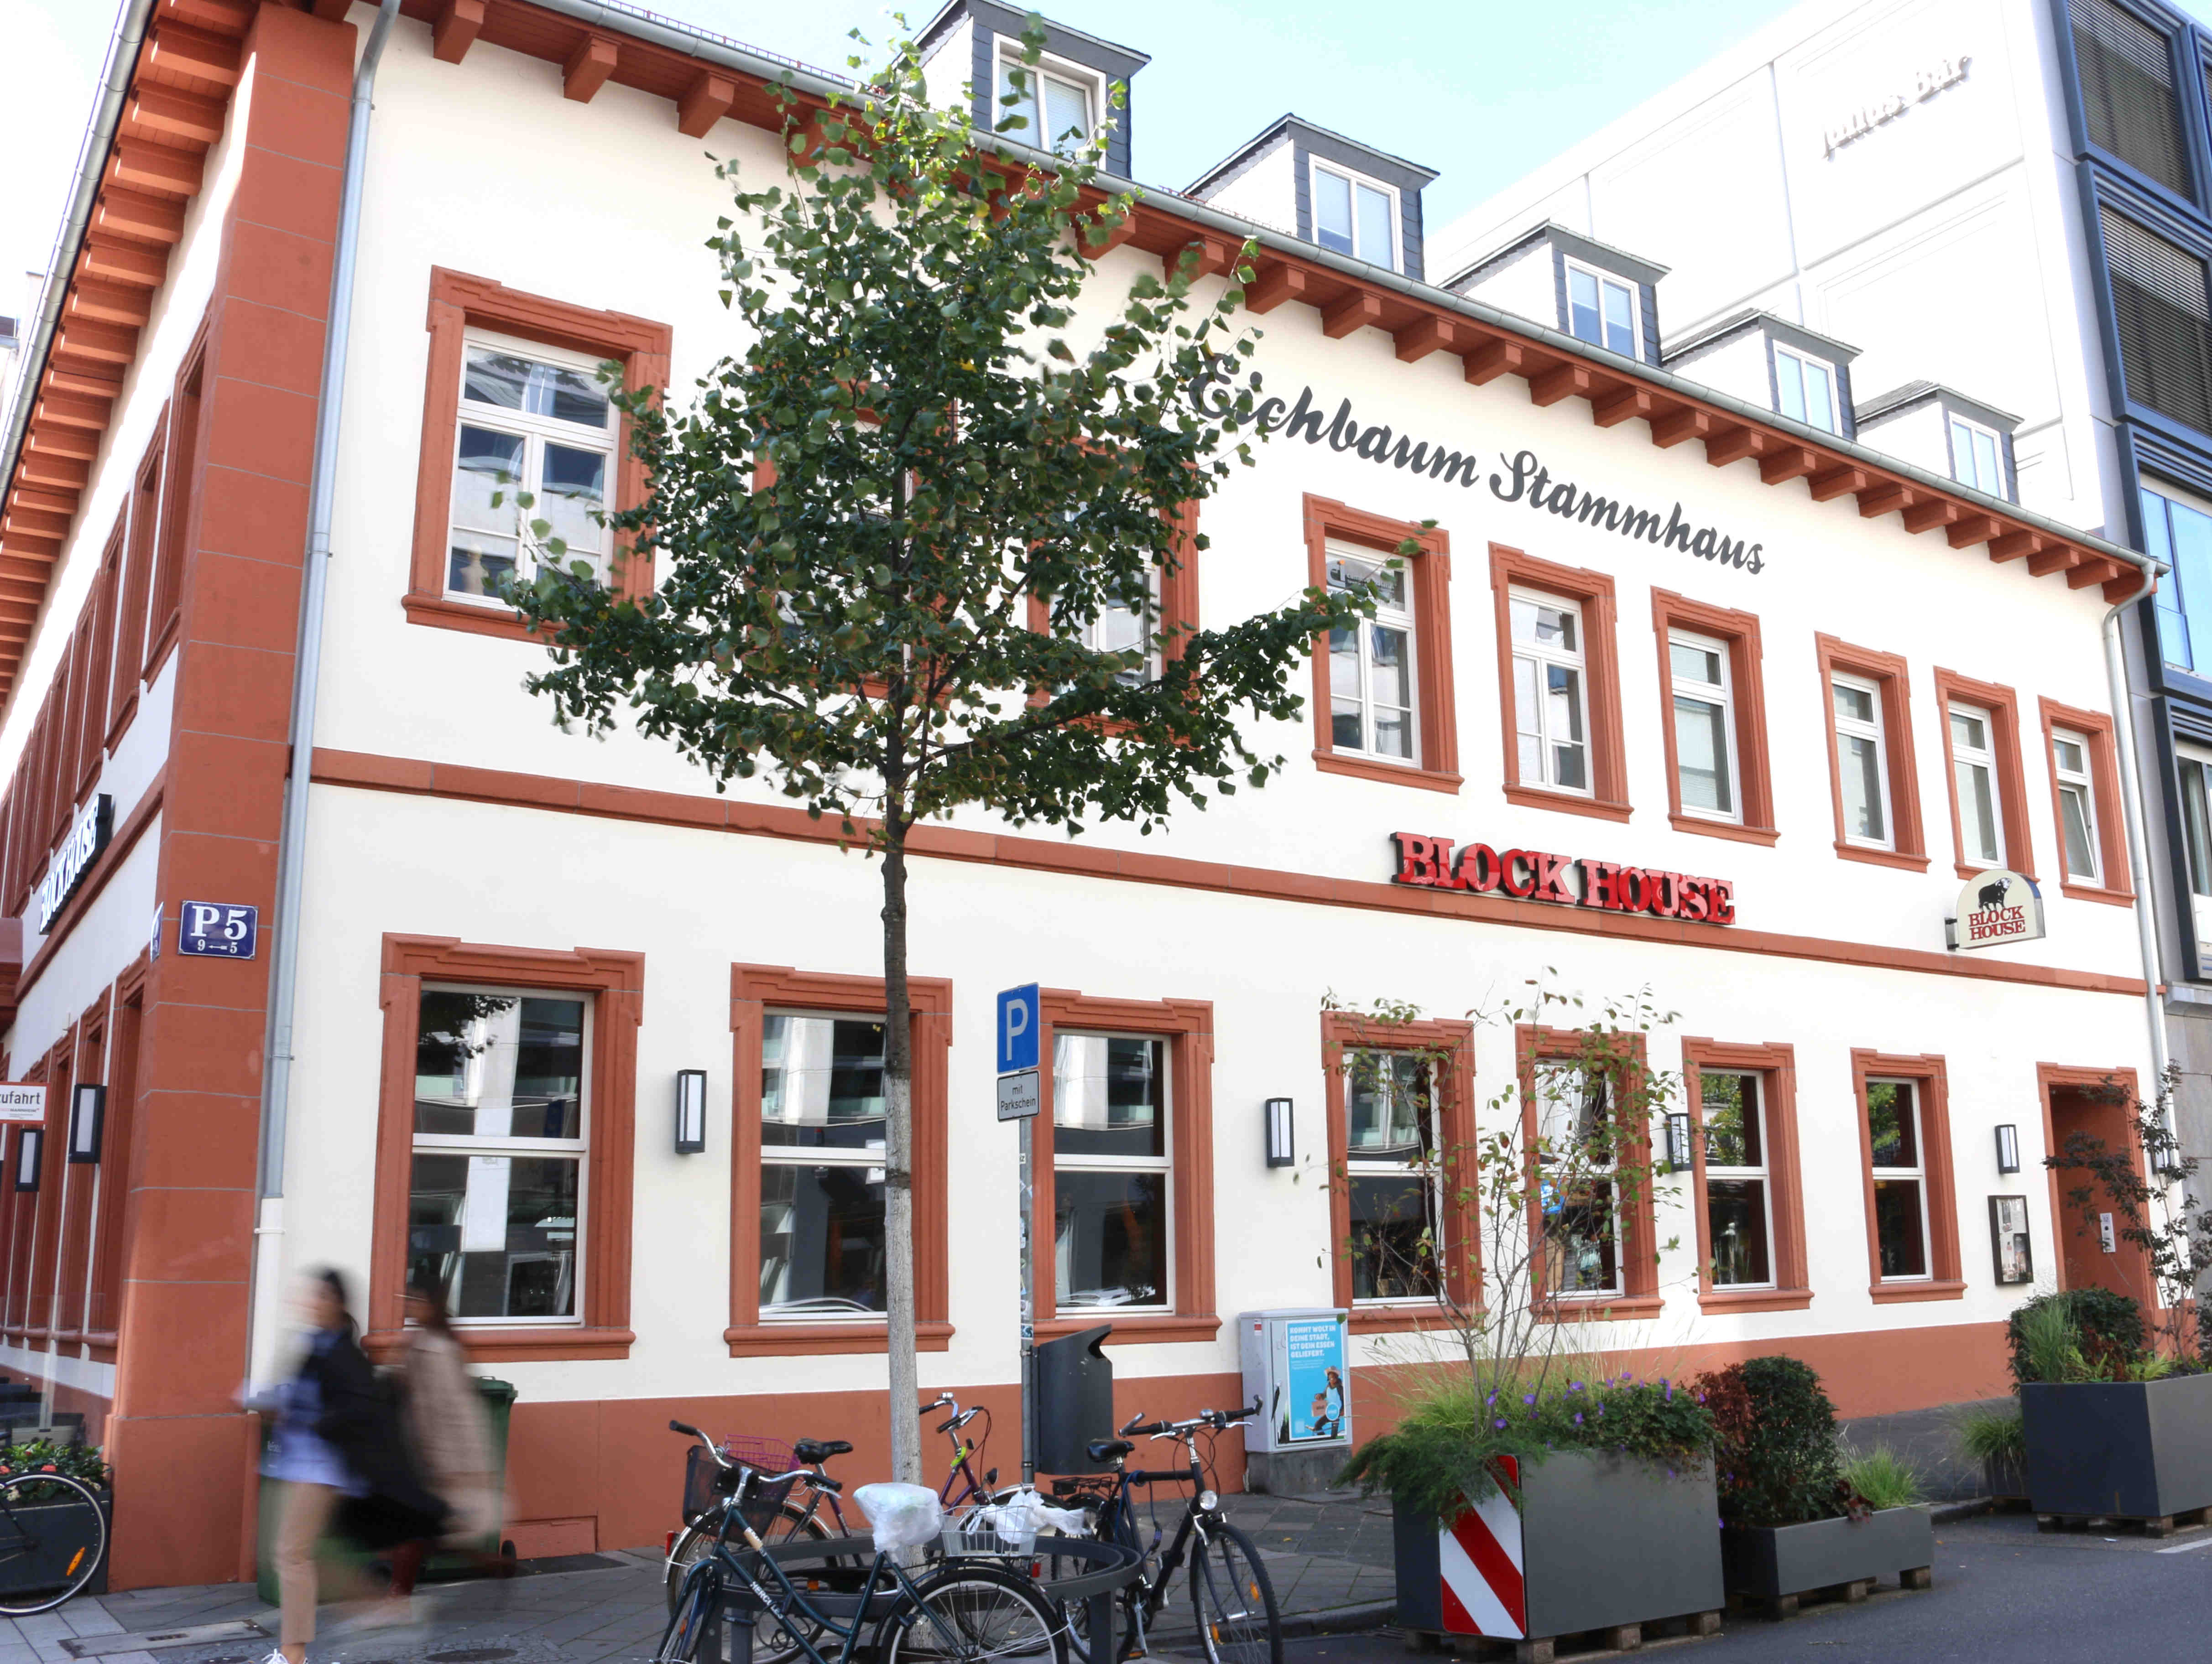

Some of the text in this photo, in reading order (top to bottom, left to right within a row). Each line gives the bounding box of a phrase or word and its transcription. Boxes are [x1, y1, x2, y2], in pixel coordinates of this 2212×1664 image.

[1488, 449, 1765, 576] Stammhaus
[1390, 831, 1736, 925] BLOCK HOUSE
[190, 905, 220, 937] P
[224, 909, 247, 941] 5
[1968, 905, 2024, 927] BLOCK
[1969, 919, 2026, 941] HOUSE
[198, 939, 238, 954] 9 5
[1007, 998, 1028, 1061] P
[0, 1091, 41, 1104] ufahrt
[1012, 1083, 1023, 1095] mit
[1001, 1096, 1036, 1112] Parkschein
[1291, 1349, 1325, 1358] GELIEFERT.
